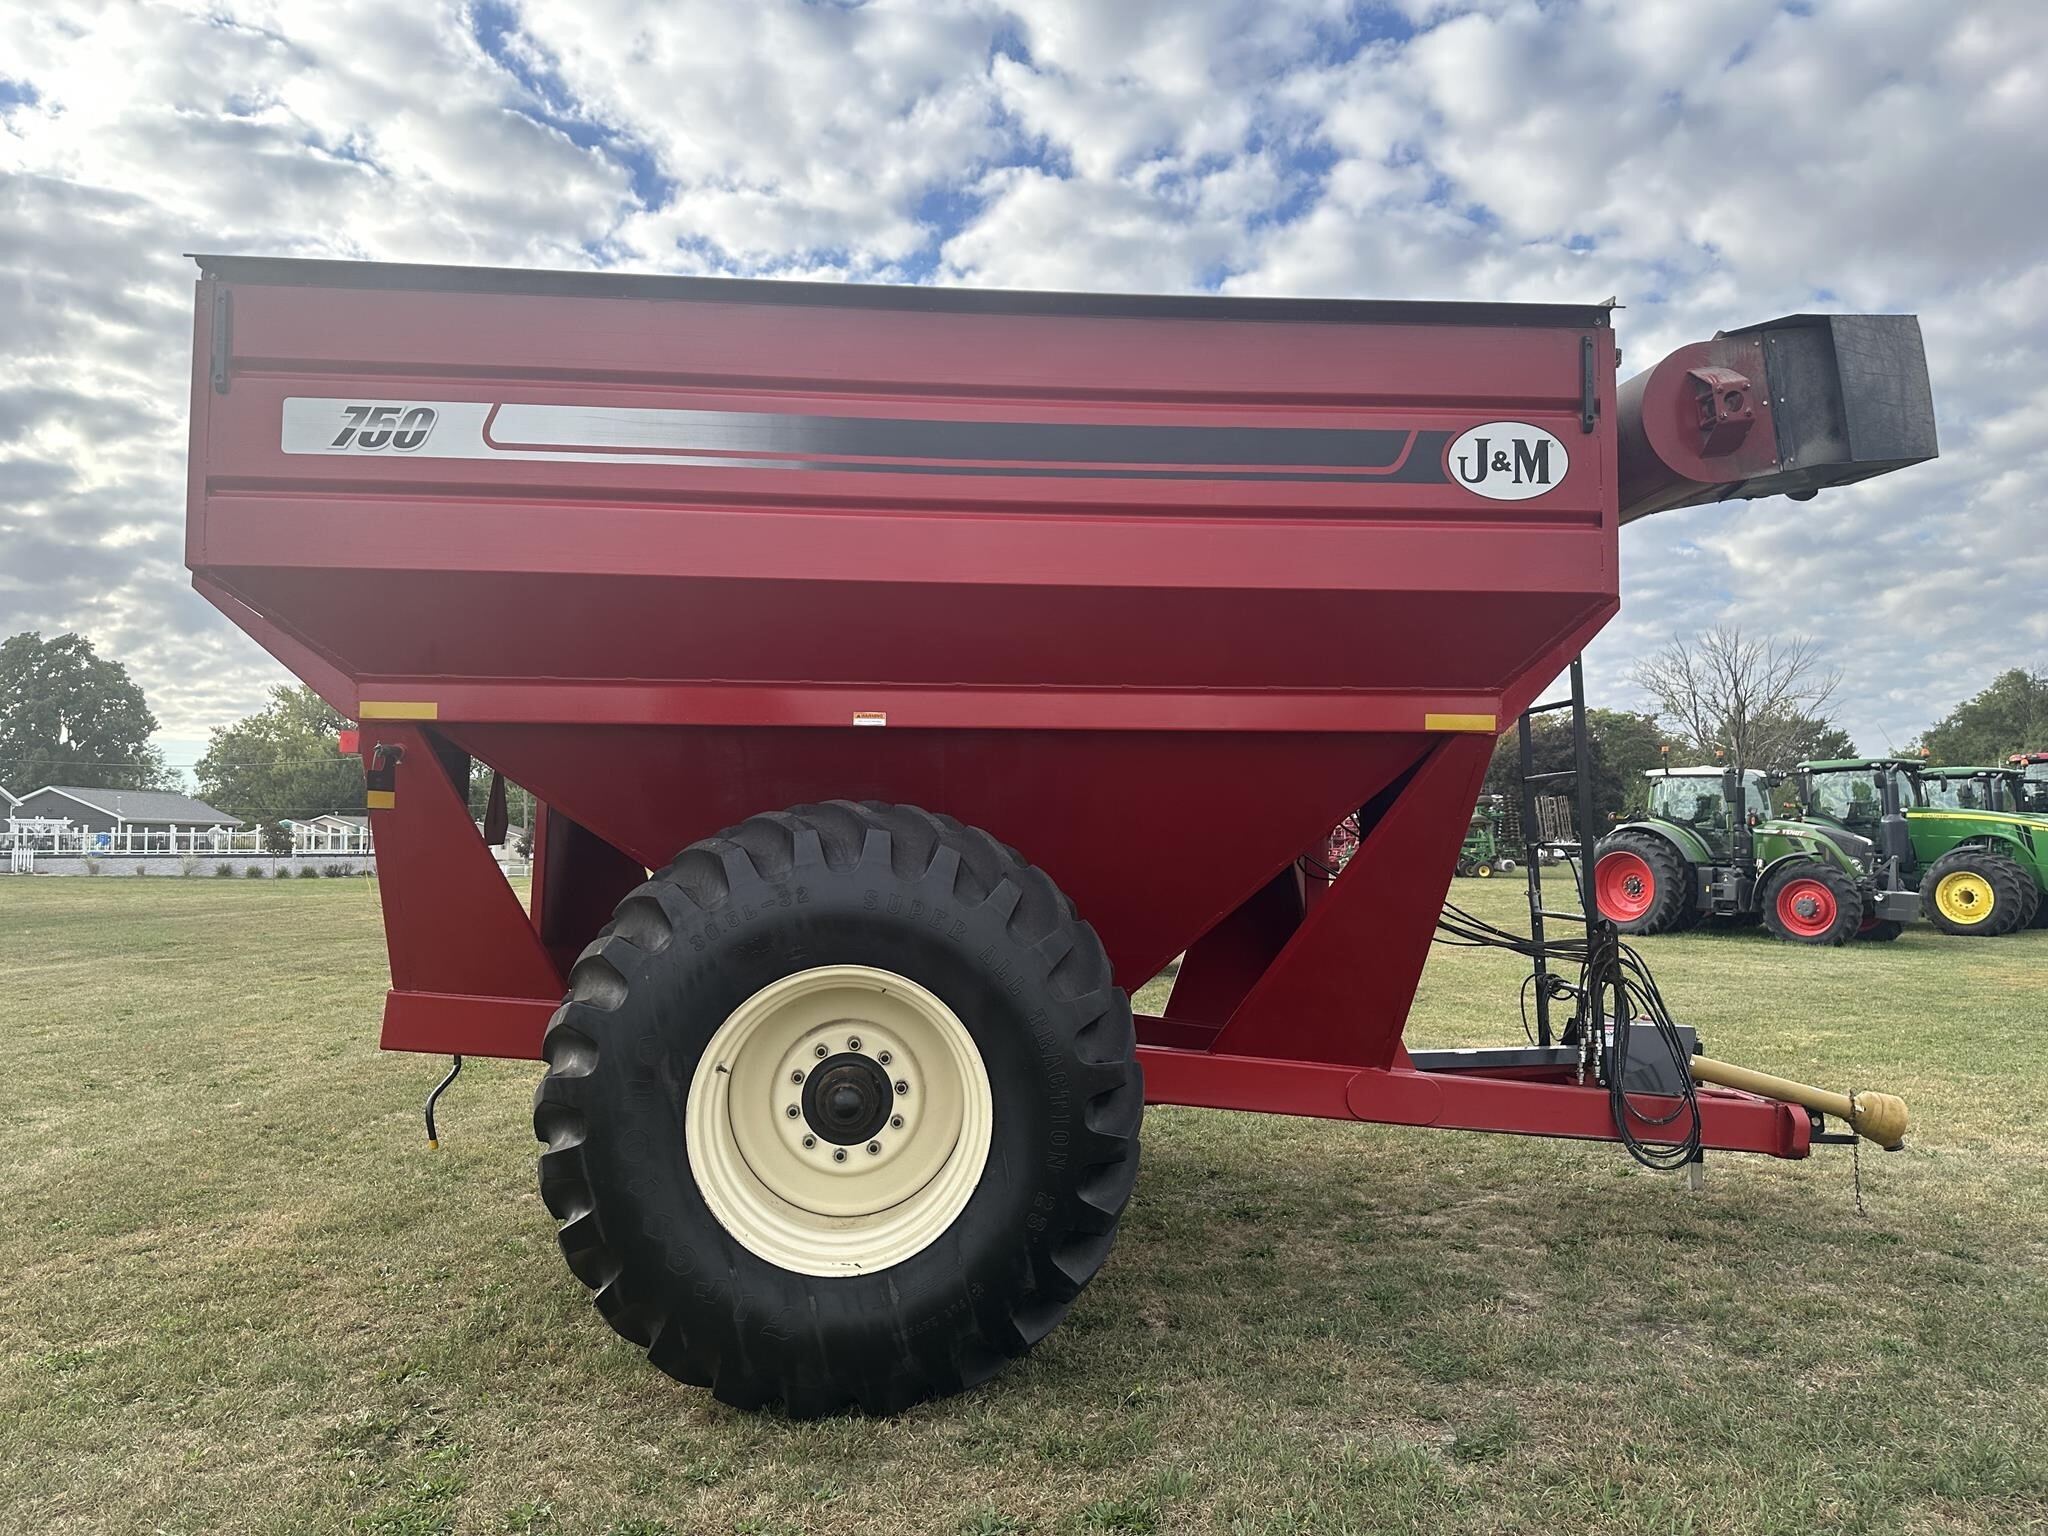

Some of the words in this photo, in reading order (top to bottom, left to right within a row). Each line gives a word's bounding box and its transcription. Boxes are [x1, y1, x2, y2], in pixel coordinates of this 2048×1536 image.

[329, 405, 437, 450] 750
[1457, 438, 1551, 484] J&M
[863, 889, 967, 942] SUPER
[978, 944, 1024, 996] ALL
[1027, 1007, 1073, 1170] TRACTION
